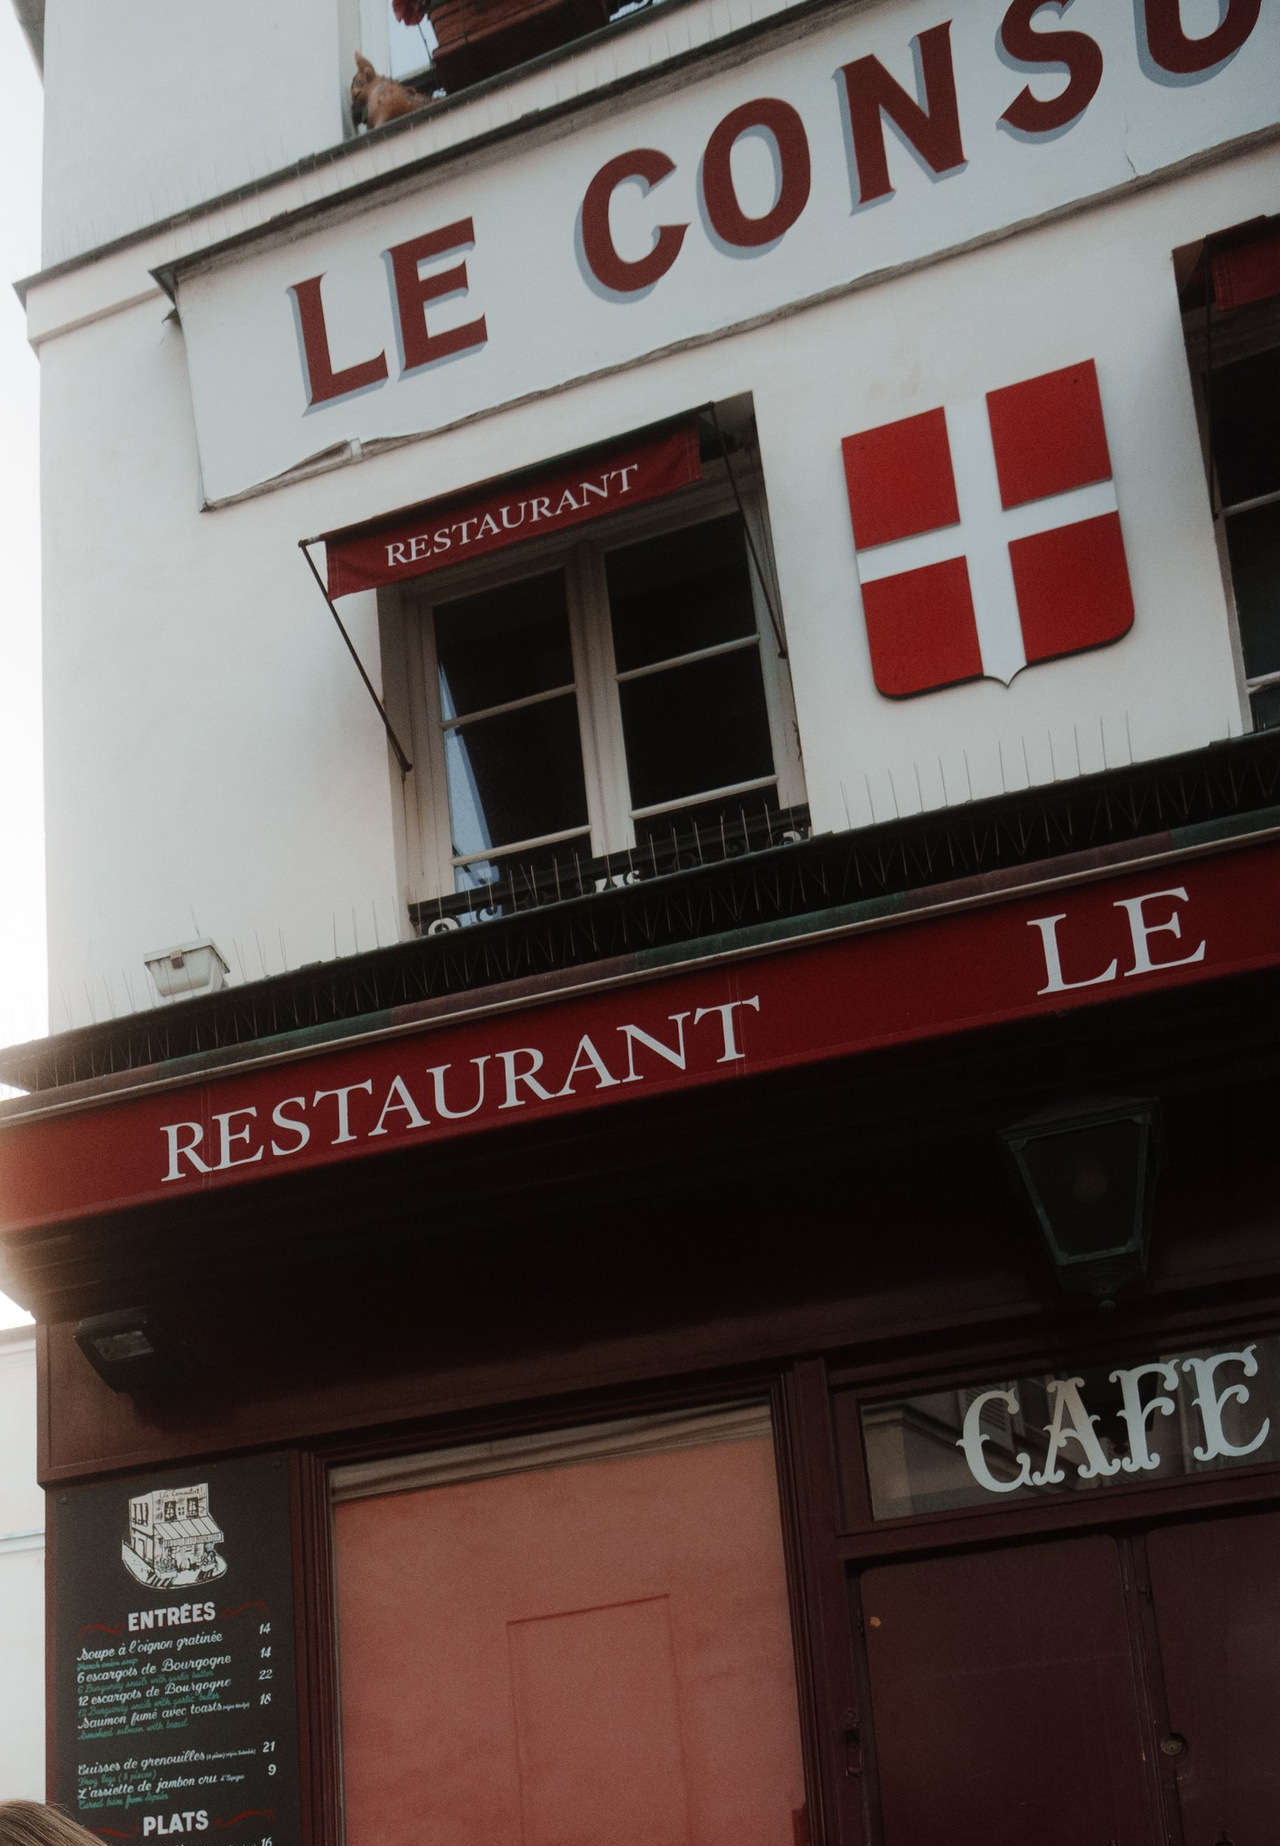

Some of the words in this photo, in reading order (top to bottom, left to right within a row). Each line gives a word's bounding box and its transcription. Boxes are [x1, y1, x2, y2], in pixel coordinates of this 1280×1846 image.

[287, 216, 489, 414] LE
[384, 463, 639, 567] RESTAURANT
[160, 994, 761, 1183] RESTAURANT
[1027, 886, 1207, 995] LE
[128, 1601, 216, 1631] ENTRÉES
[77, 1647, 116, 1661] Soupe
[117, 1643, 128, 1656] à
[128, 1639, 173, 1655] l'oignon
[176, 1630, 223, 1652] gratinée
[259, 1622, 272, 1635] 14
[77, 1671, 85, 1684] 6
[86, 1665, 138, 1683] escargots
[141, 1662, 158, 1675] de
[161, 1654, 232, 1673] Bourgogne
[260, 1645, 272, 1659] 14
[78, 1695, 90, 1707] 12
[91, 1689, 142, 1706] escargots
[146, 1685, 161, 1698] de
[165, 1678, 232, 1696] Bourgogne
[259, 1668, 273, 1681] 22
[77, 1715, 127, 1730] Saumon
[130, 1708, 158, 1727] fumé
[161, 1706, 187, 1719] avec
[190, 1701, 222, 1715] toasts
[260, 1692, 272, 1706] 18
[78, 1761, 121, 1776] Cuisses
[123, 1757, 139, 1771] de
[141, 1749, 205, 1771] grenouilles
[262, 1740, 276, 1753] 21
[78, 1783, 135, 1800] L'assiette
[137, 1779, 153, 1792] de
[155, 1776, 195, 1794] jambon
[198, 1774, 218, 1785] cru
[267, 1763, 277, 1776] 9
[142, 1809, 209, 1838] PLATS
